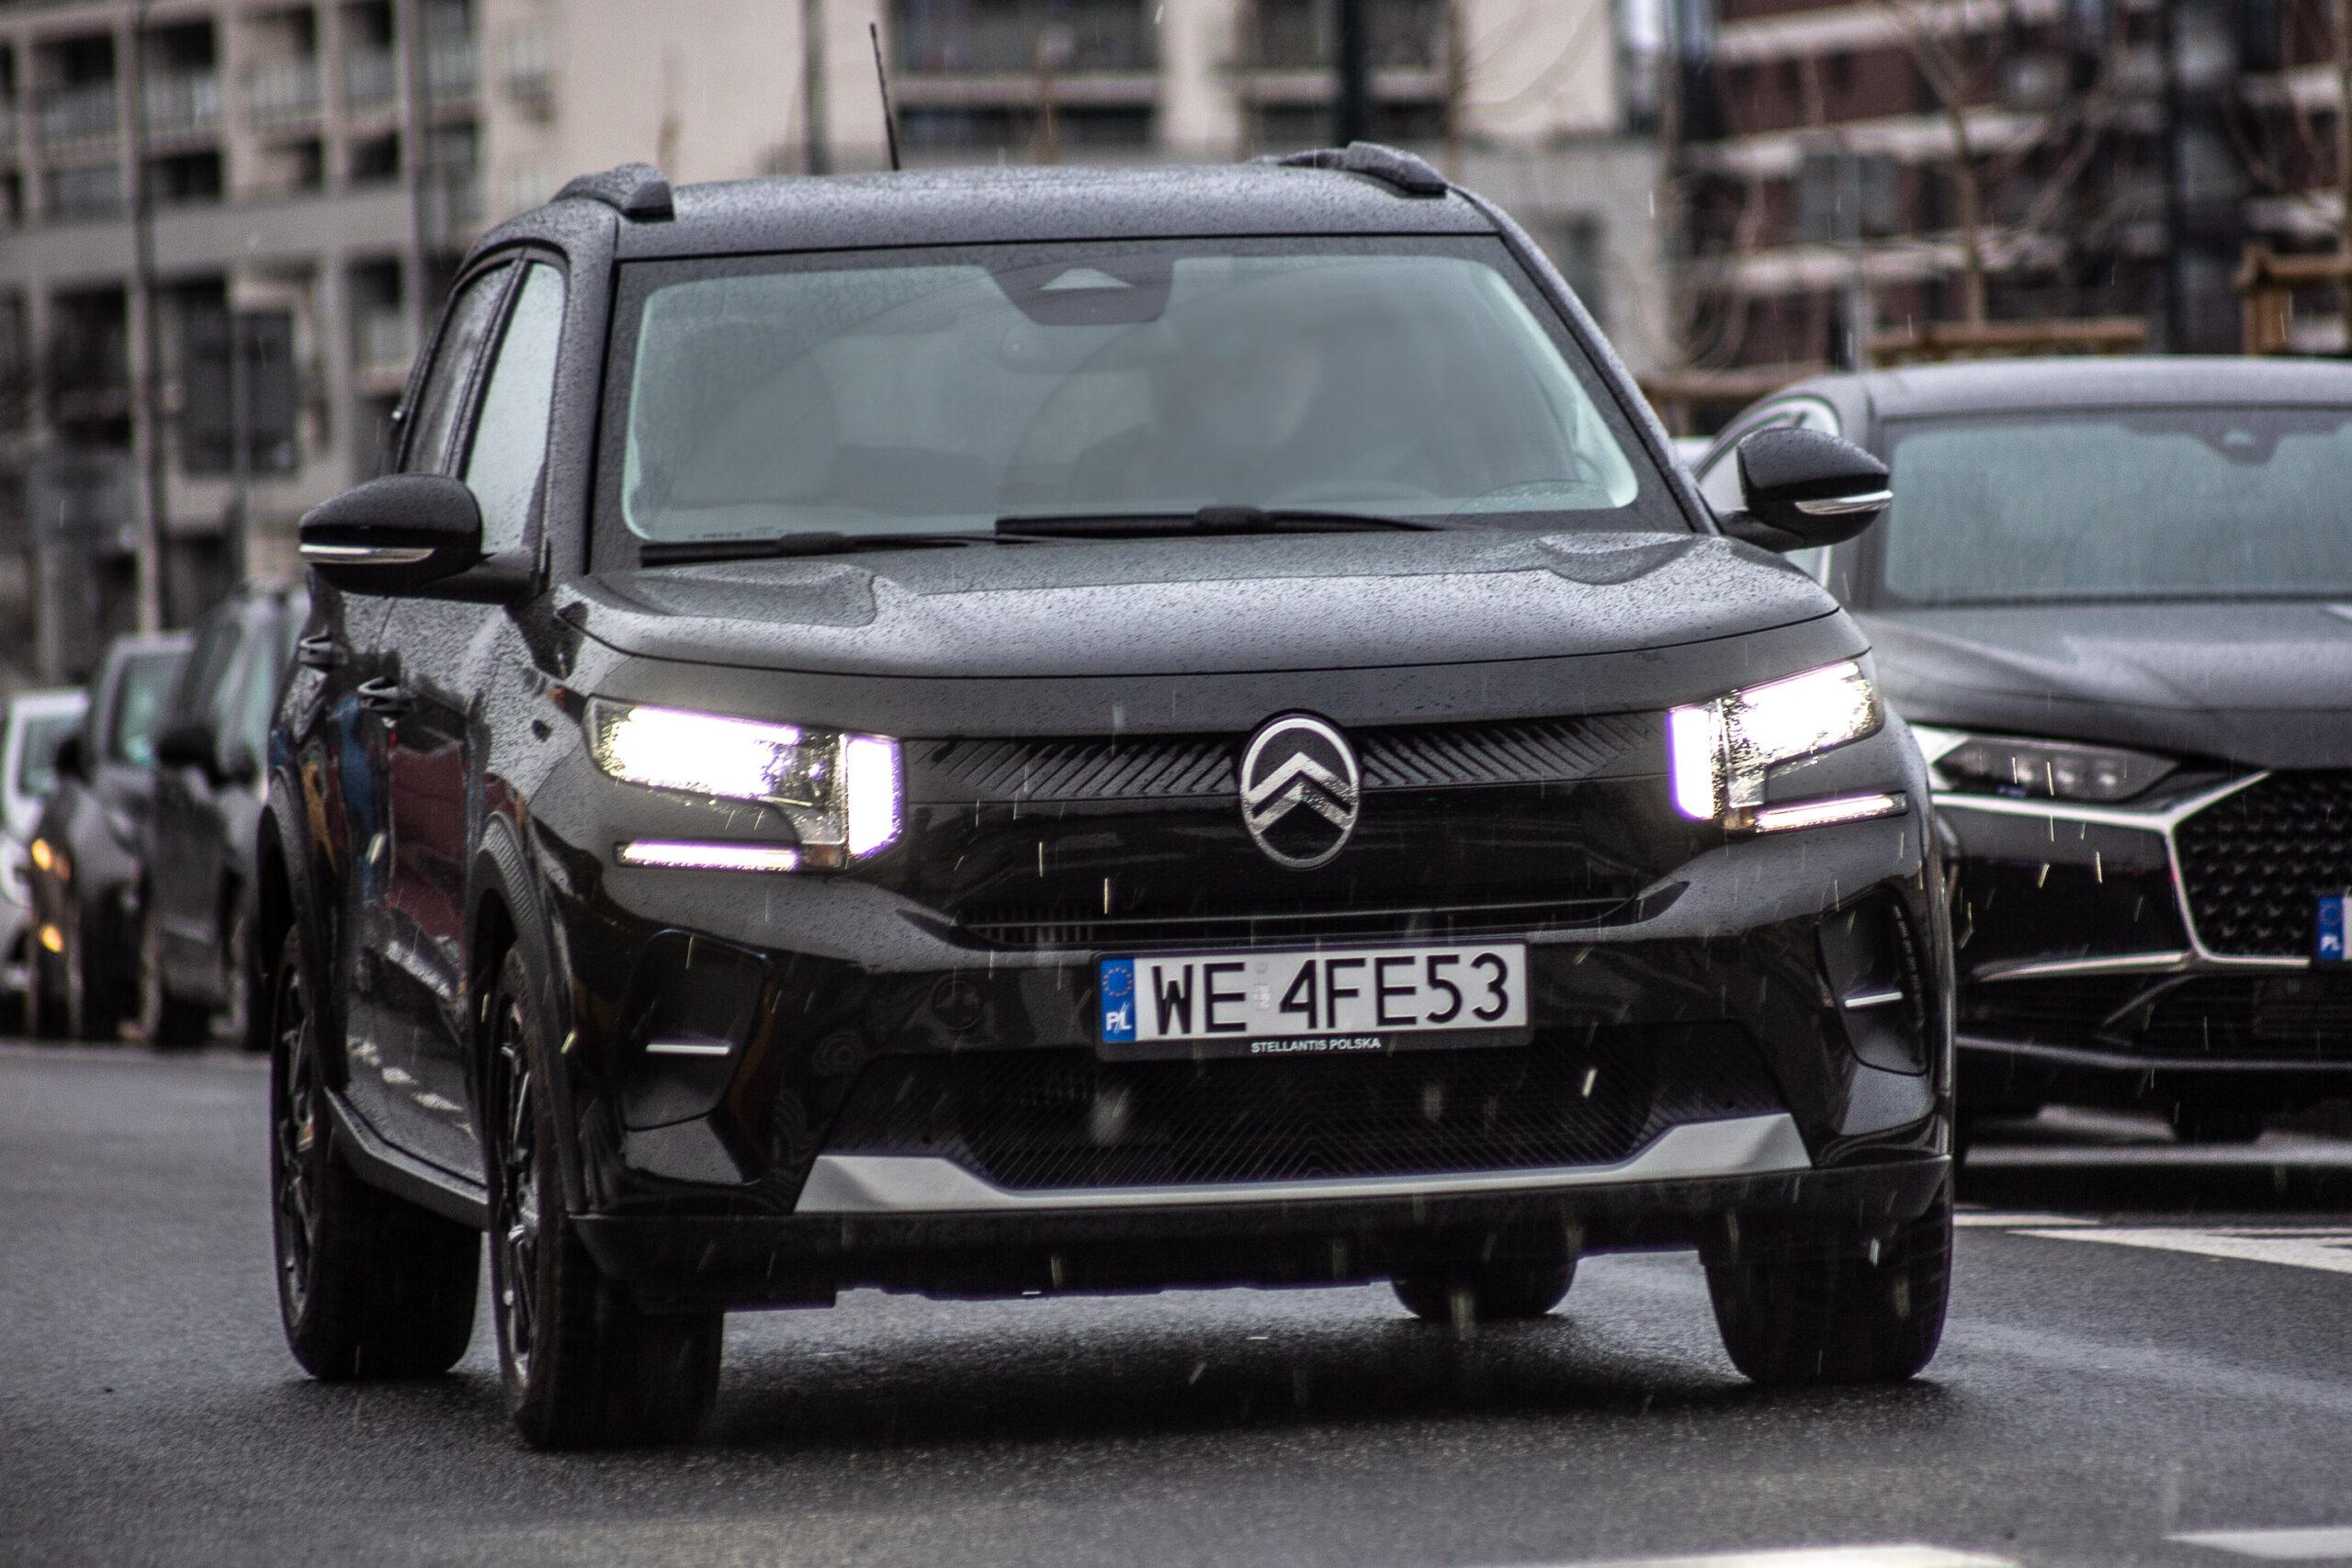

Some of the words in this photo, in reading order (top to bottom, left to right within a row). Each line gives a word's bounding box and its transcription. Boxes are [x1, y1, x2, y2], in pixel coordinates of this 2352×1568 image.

[1151, 962, 1248, 1035] WE
[1279, 953, 1510, 1030] 4FE53
[1105, 1010, 1132, 1032] PL
[1250, 1040, 1328, 1054] STELLANTIS
[1329, 1037, 1382, 1050] POLSKA
